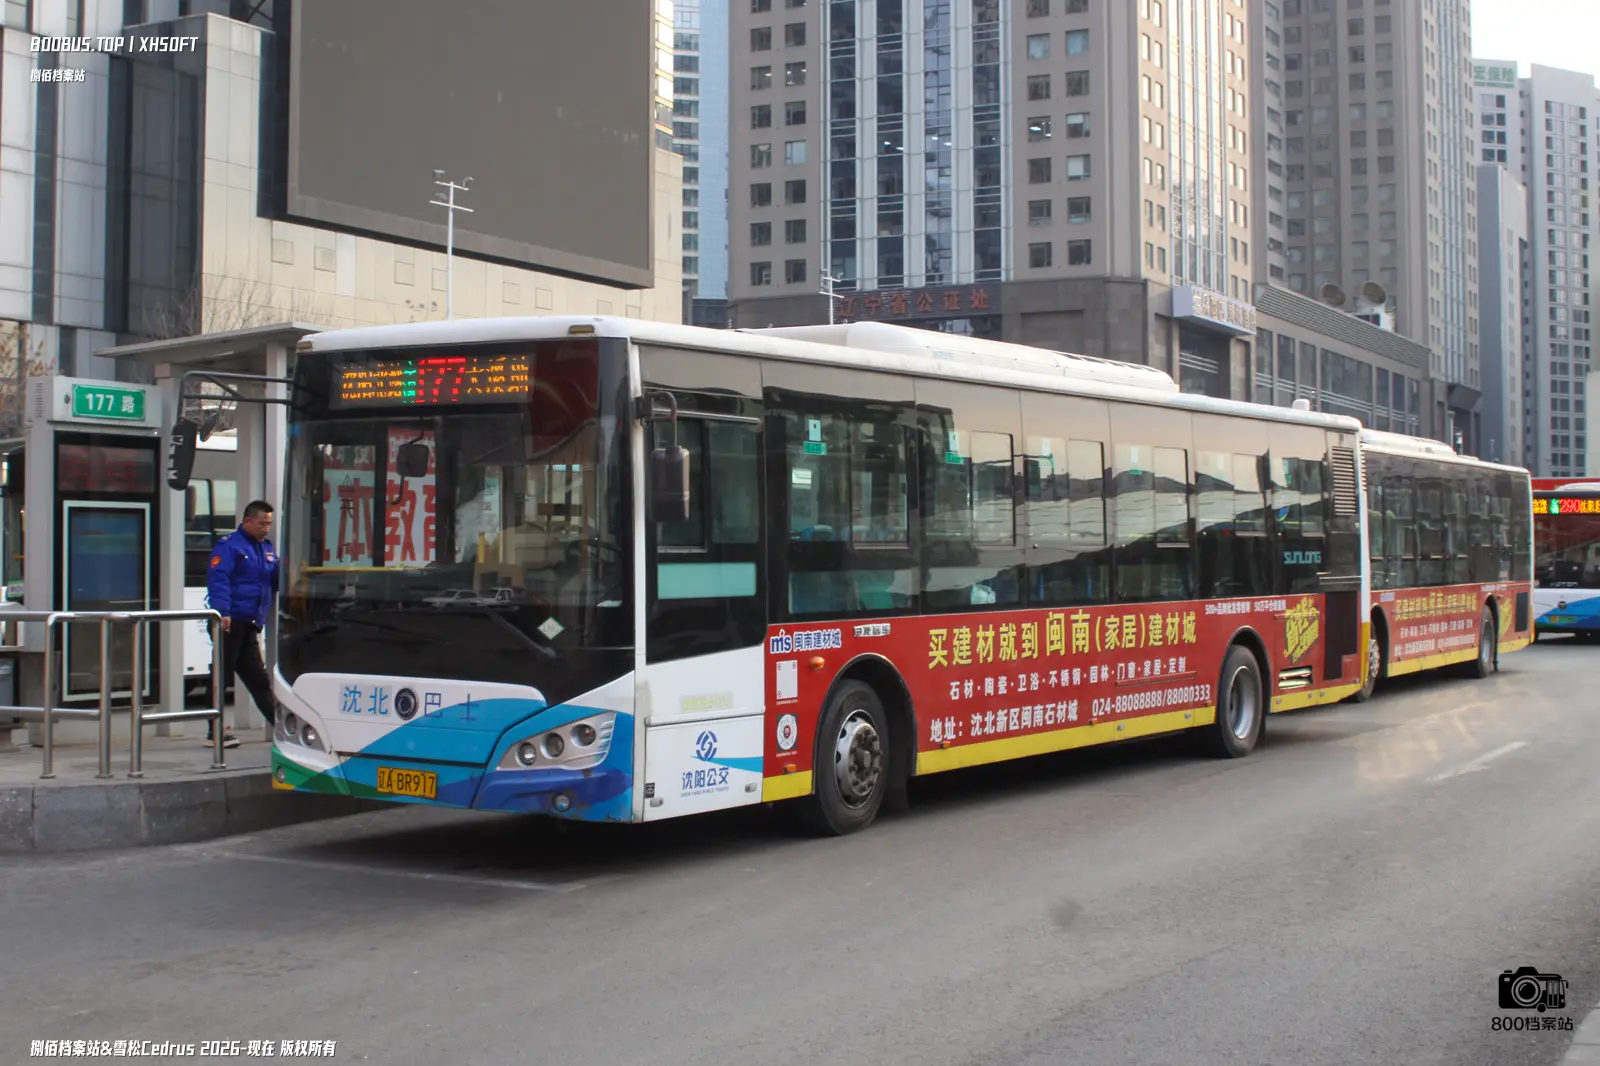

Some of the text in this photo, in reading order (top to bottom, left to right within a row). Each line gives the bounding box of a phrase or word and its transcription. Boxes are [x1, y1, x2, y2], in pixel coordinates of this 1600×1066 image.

[839, 289, 990, 317] 辽宁省公证处
[85, 393, 135, 413] 177 路
[1559, 498, 1580, 514] 290
[1284, 551, 1322, 564] SUNLONG
[793, 630, 841, 651] 闽南建材城
[343, 685, 480, 722] 沈北 巴士
[1092, 684, 1211, 717] 024-88088888/88080333
[682, 766, 730, 790] 沈阳公交
